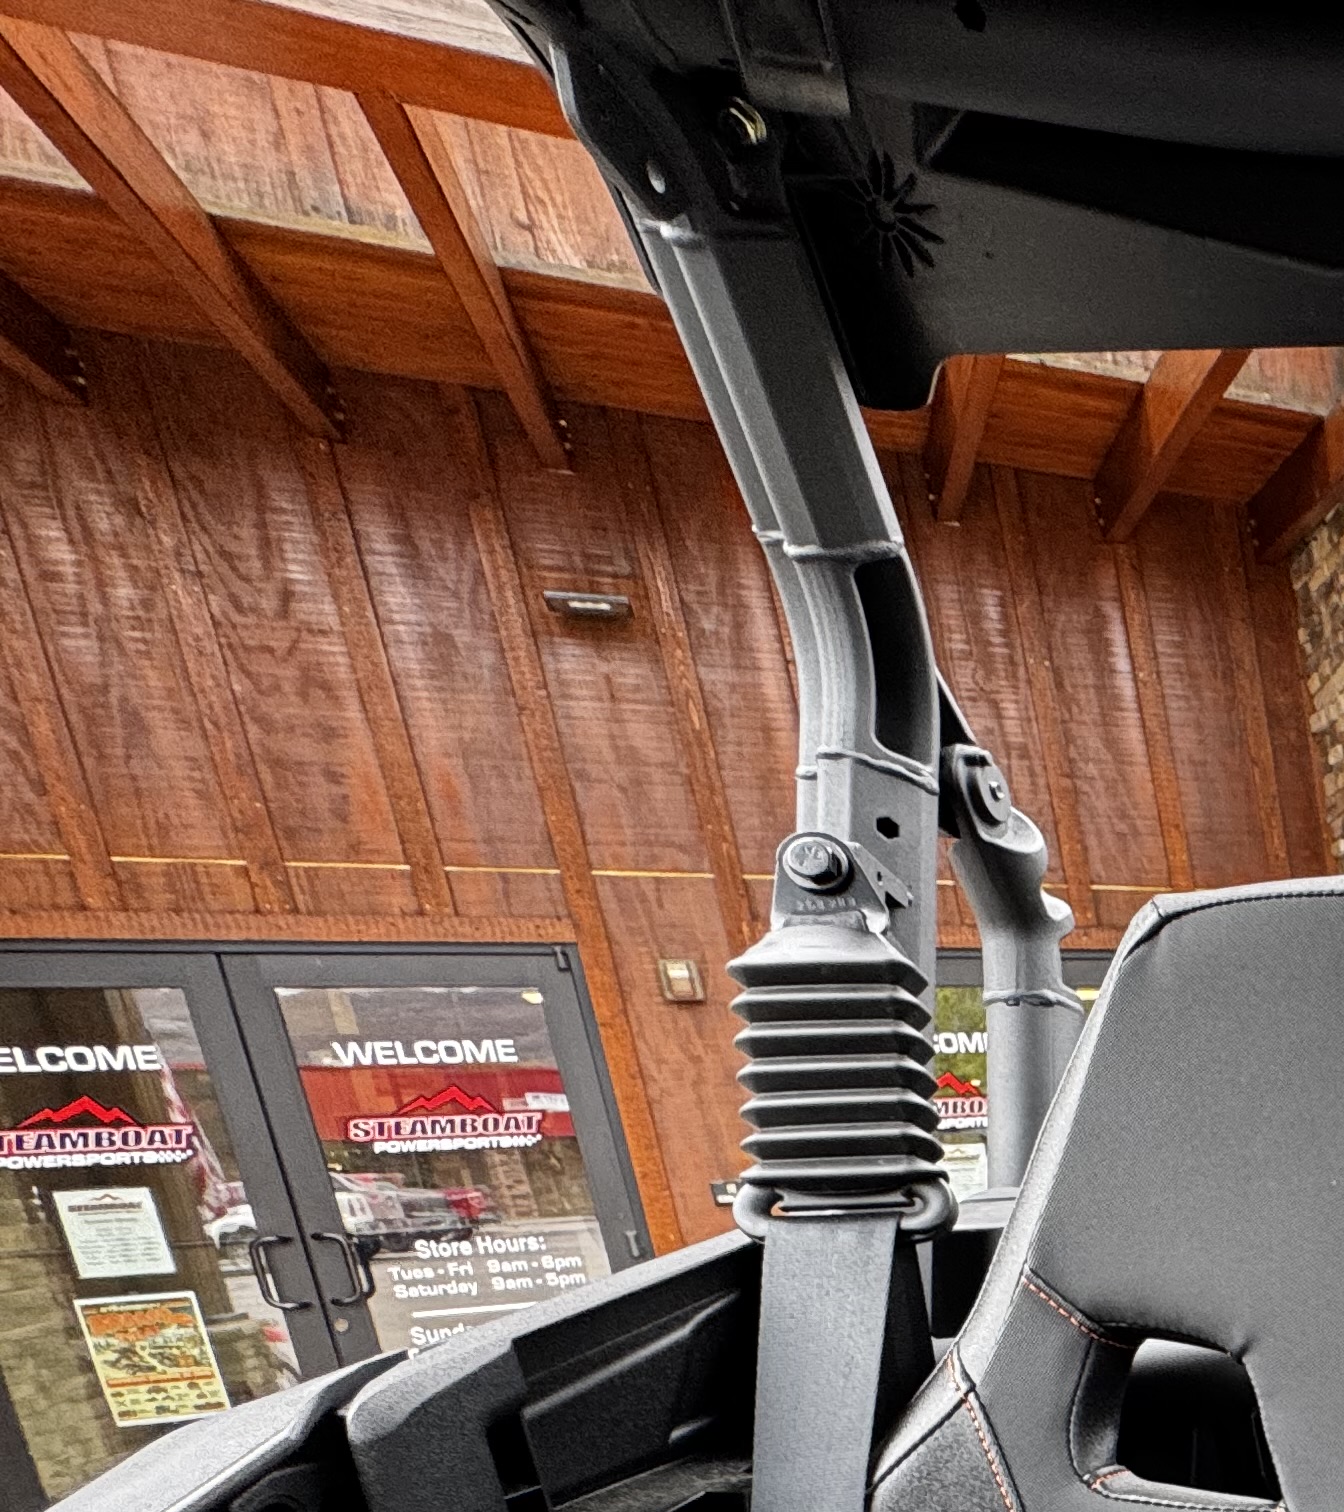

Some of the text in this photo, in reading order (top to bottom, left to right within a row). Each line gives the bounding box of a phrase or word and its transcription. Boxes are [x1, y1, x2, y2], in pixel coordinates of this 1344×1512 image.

[332, 1039, 518, 1066] WELCOME
[348, 1112, 543, 1142] STEAMBOAT
[373, 1136, 511, 1154] POWERSPORTS
[0, 1151, 160, 1169] OWERSPORTS
[414, 1235, 547, 1260] Store Hours:
[387, 1265, 435, 1281] Tues
[447, 1261, 474, 1277] Fri
[486, 1258, 529, 1274] 9am
[393, 1280, 479, 1300] Saturday
[491, 1276, 534, 1291] 9am
